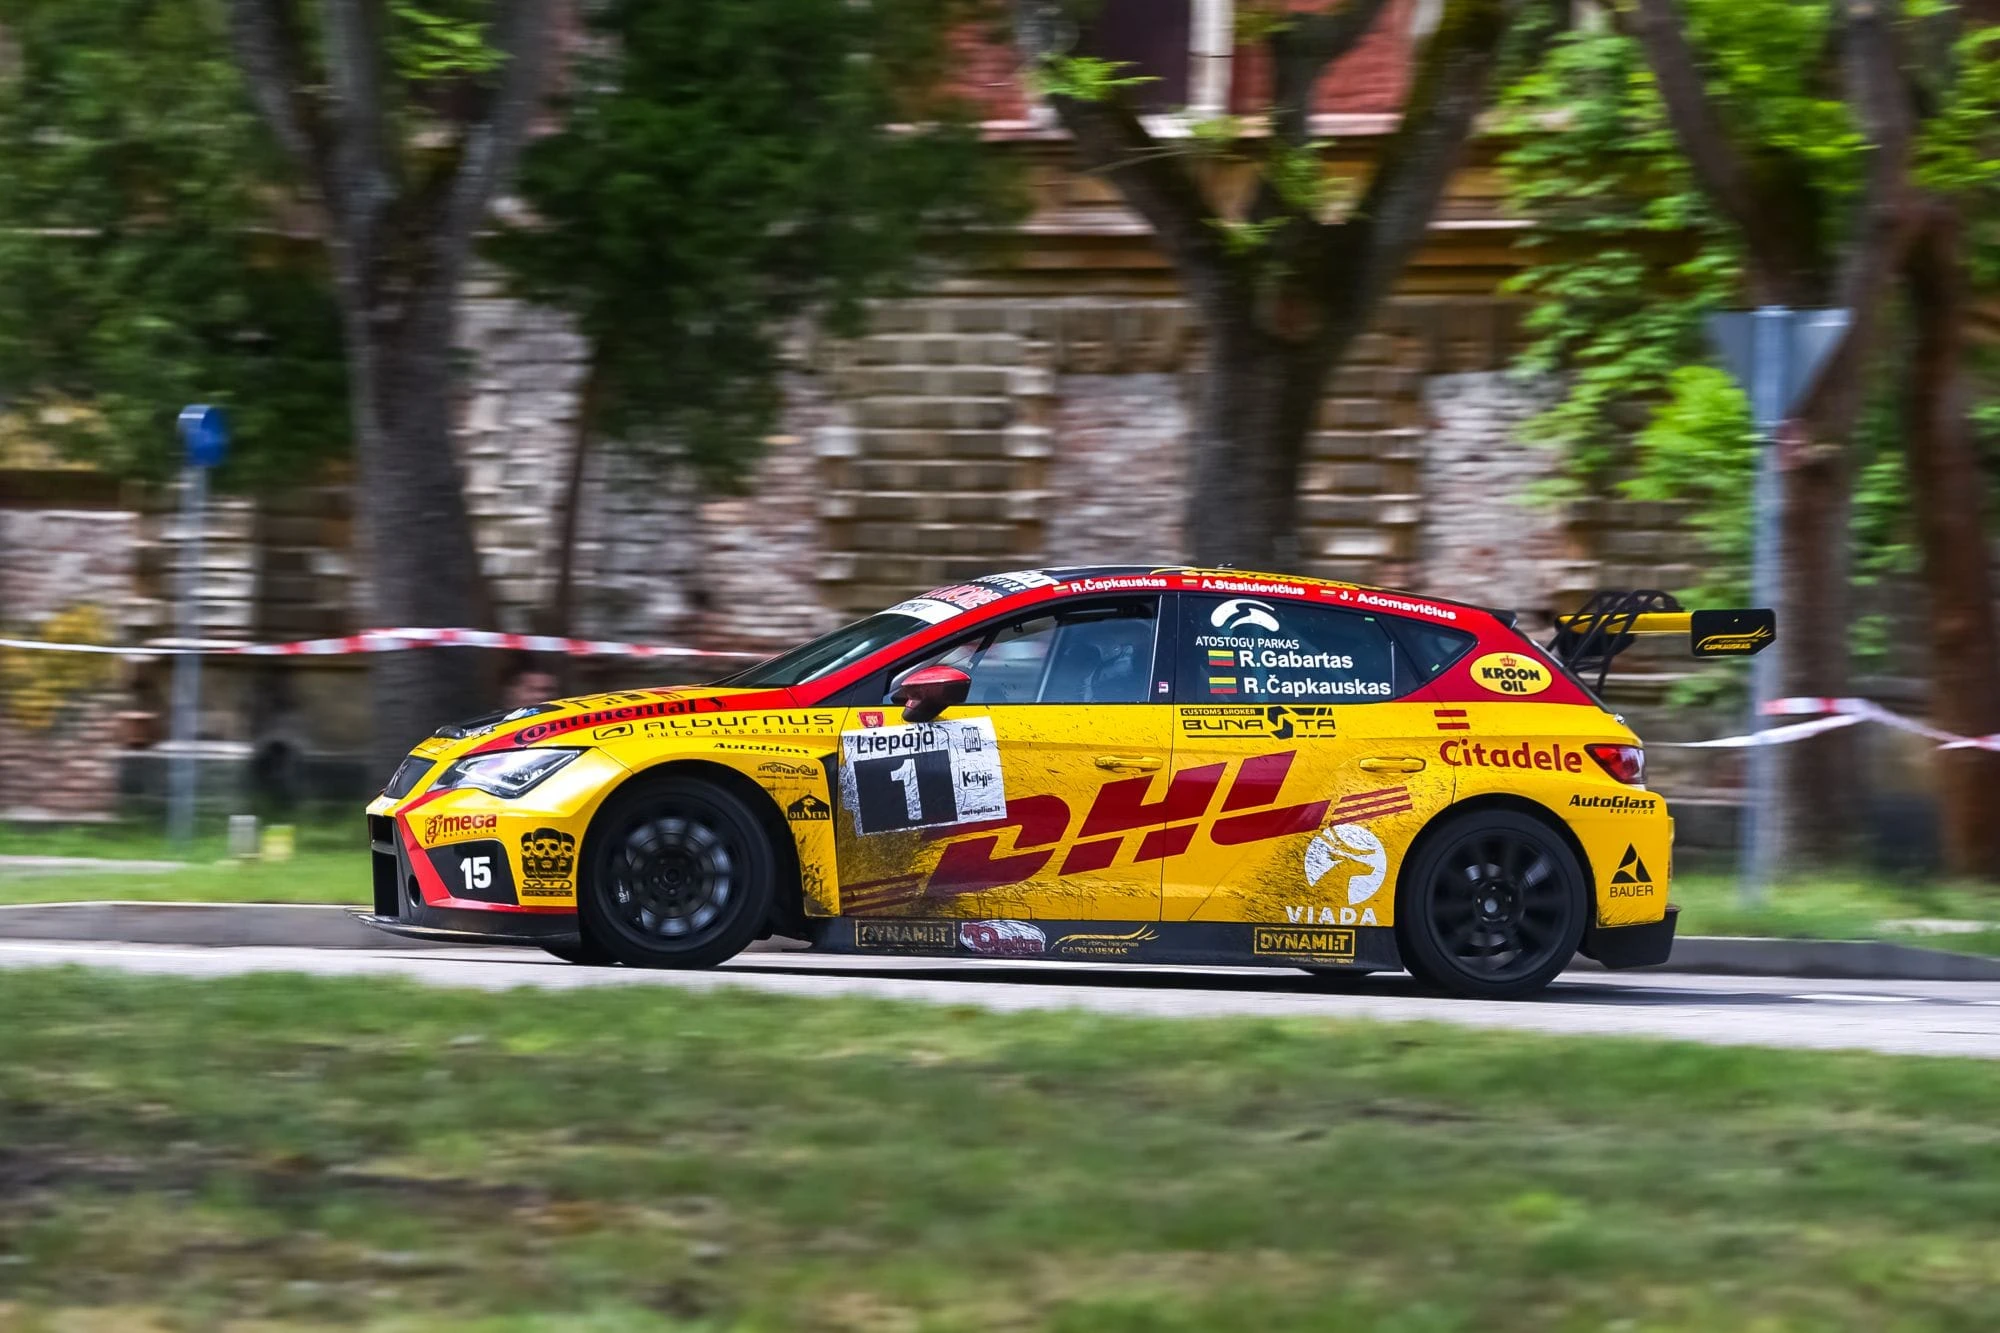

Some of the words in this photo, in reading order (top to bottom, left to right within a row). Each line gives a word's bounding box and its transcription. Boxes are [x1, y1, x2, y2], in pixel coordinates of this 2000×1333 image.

[1071, 577, 1167, 592] R.Čapkauskas
[1339, 591, 1354, 602] J.
[1357, 593, 1457, 621] Adomavičius
[1196, 636, 1255, 650] ATOSTOGŲ
[1258, 638, 1300, 650] PARKAS
[1239, 651, 1354, 669] R.Gabartas
[1482, 667, 1541, 682] KROON
[1243, 674, 1392, 697] R.Čapkauskas
[1500, 681, 1527, 693] OIL
[514, 698, 697, 745] Continental
[1223, 708, 1256, 716] BROKER
[647, 730, 694, 738] auto
[711, 726, 834, 736] aksesuarai
[856, 728, 935, 755] Liepāja
[1439, 738, 1583, 774] Citadele
[890, 758, 923, 821] 1
[1569, 795, 1656, 809] AutoGlass
[920, 750, 1331, 898] DHL
[459, 856, 491, 890] 15
[1609, 885, 1654, 897] BAUER
[1285, 905, 1378, 925] VIADA
